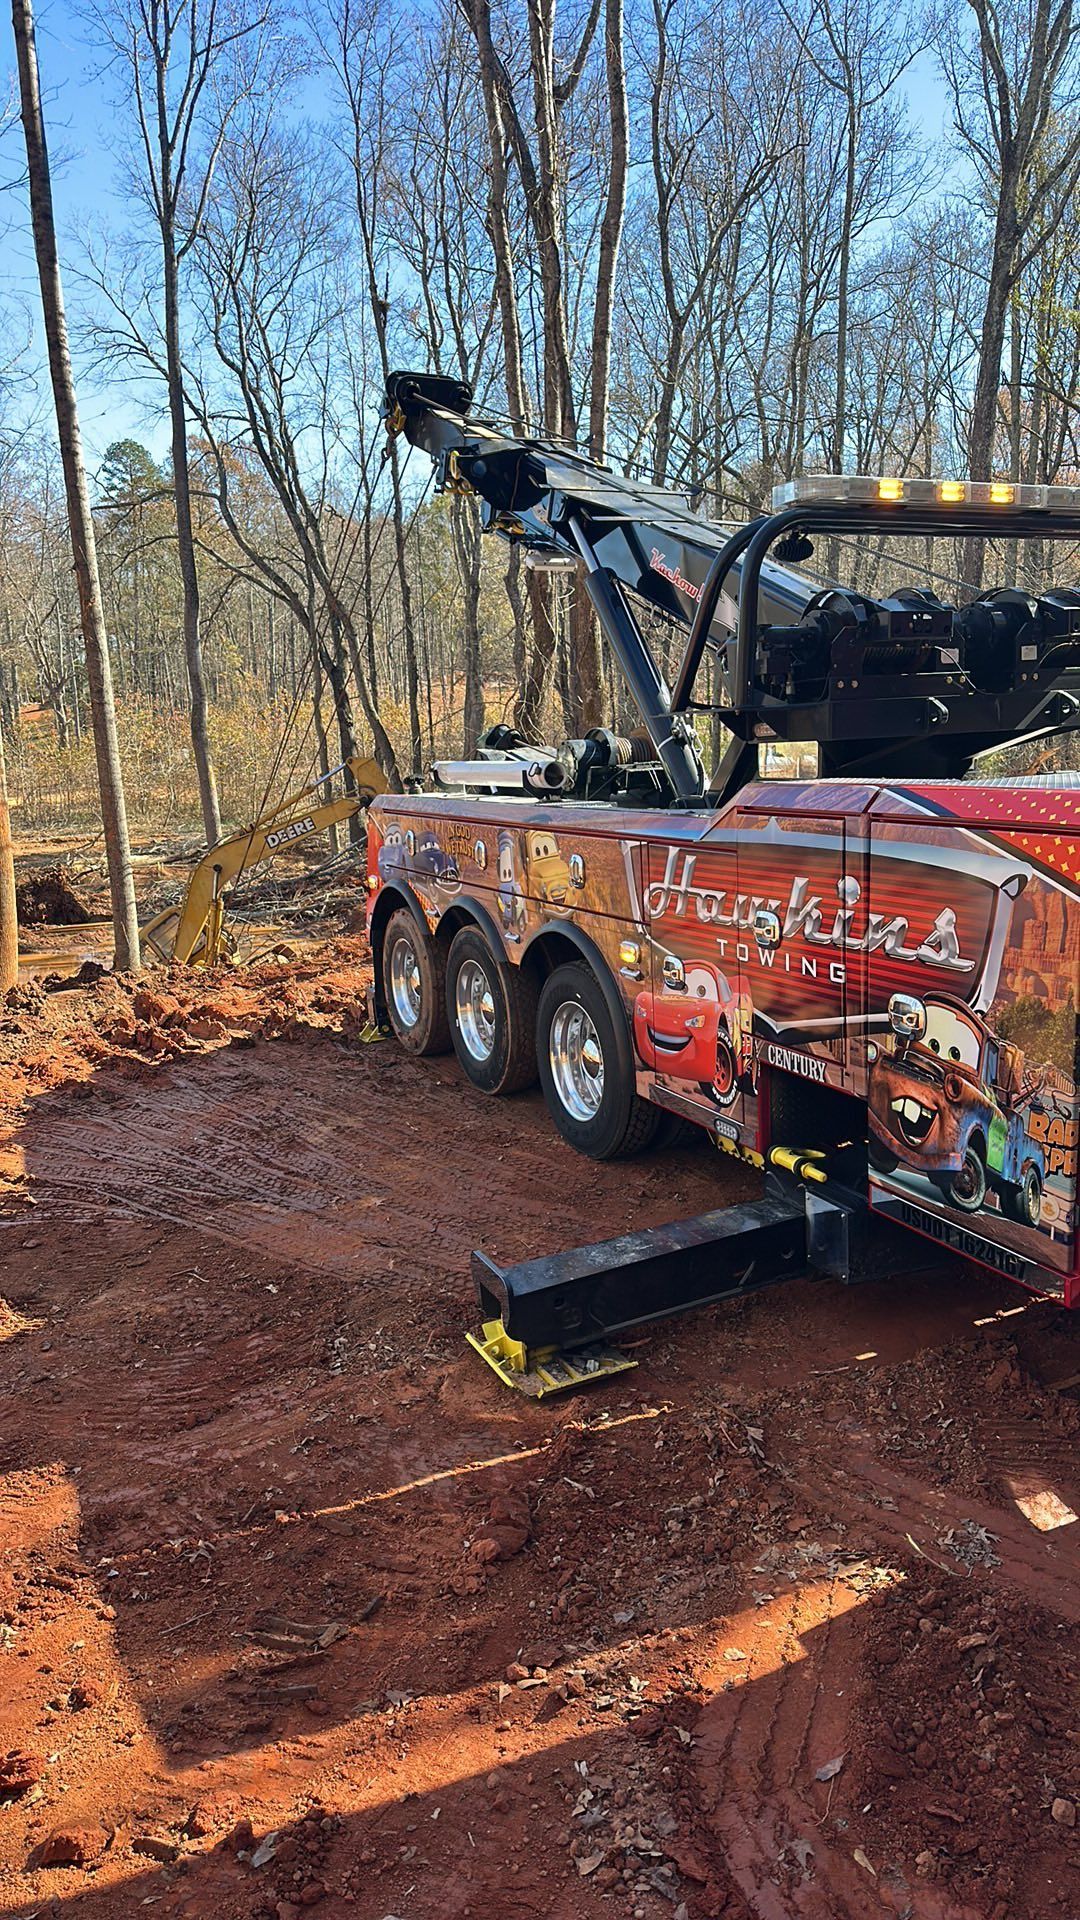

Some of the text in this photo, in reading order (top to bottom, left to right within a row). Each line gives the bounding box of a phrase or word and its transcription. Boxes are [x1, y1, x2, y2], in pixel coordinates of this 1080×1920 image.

[266, 817, 315, 848] DEERE
[644, 846, 976, 972] Hawkins
[716, 938, 846, 983] TOWING
[767, 1044, 827, 1083] CENTURY
